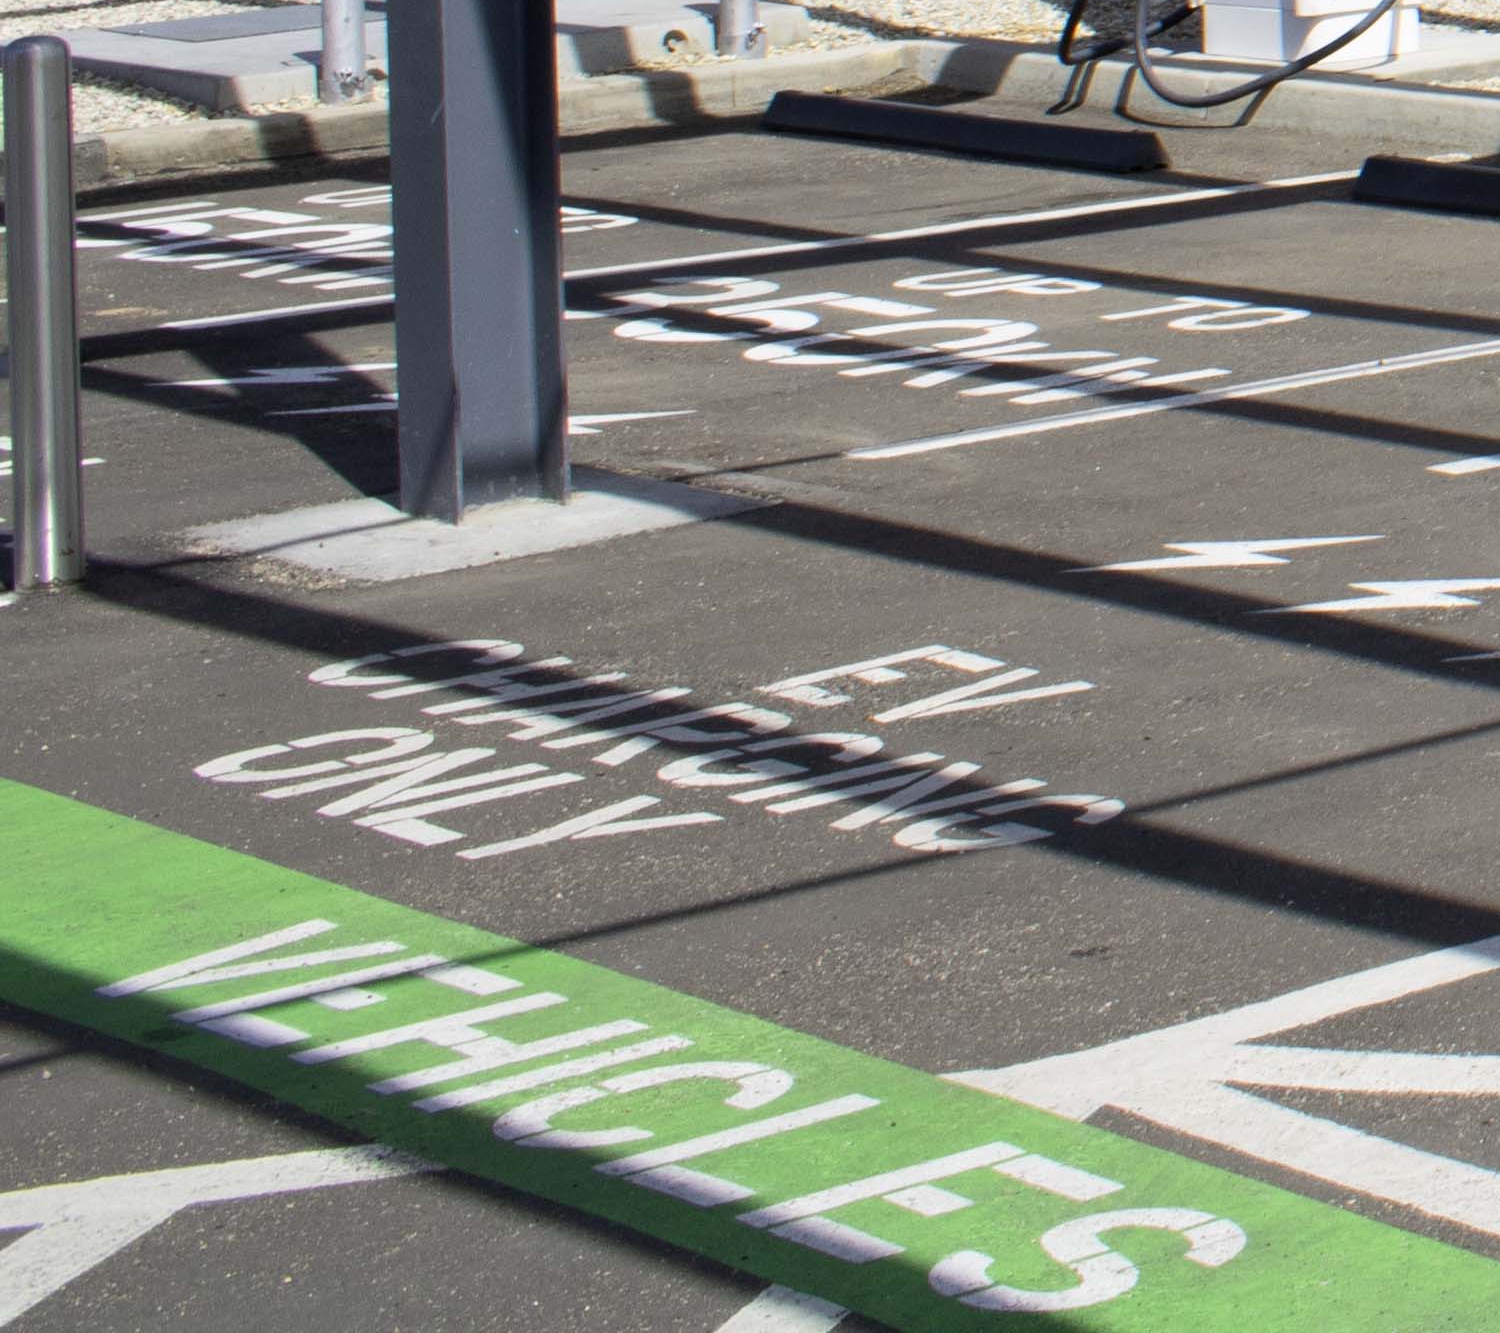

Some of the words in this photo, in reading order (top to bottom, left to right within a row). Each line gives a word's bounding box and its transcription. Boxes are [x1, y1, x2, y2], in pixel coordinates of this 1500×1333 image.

[894, 266, 1104, 298] UP
[1100, 295, 1312, 332] TO
[307, 638, 1127, 852] CHARGING
[755, 644, 1097, 724] EV
[193, 726, 727, 860] ONLY
[95, 916, 1248, 1313] VEHICLES
